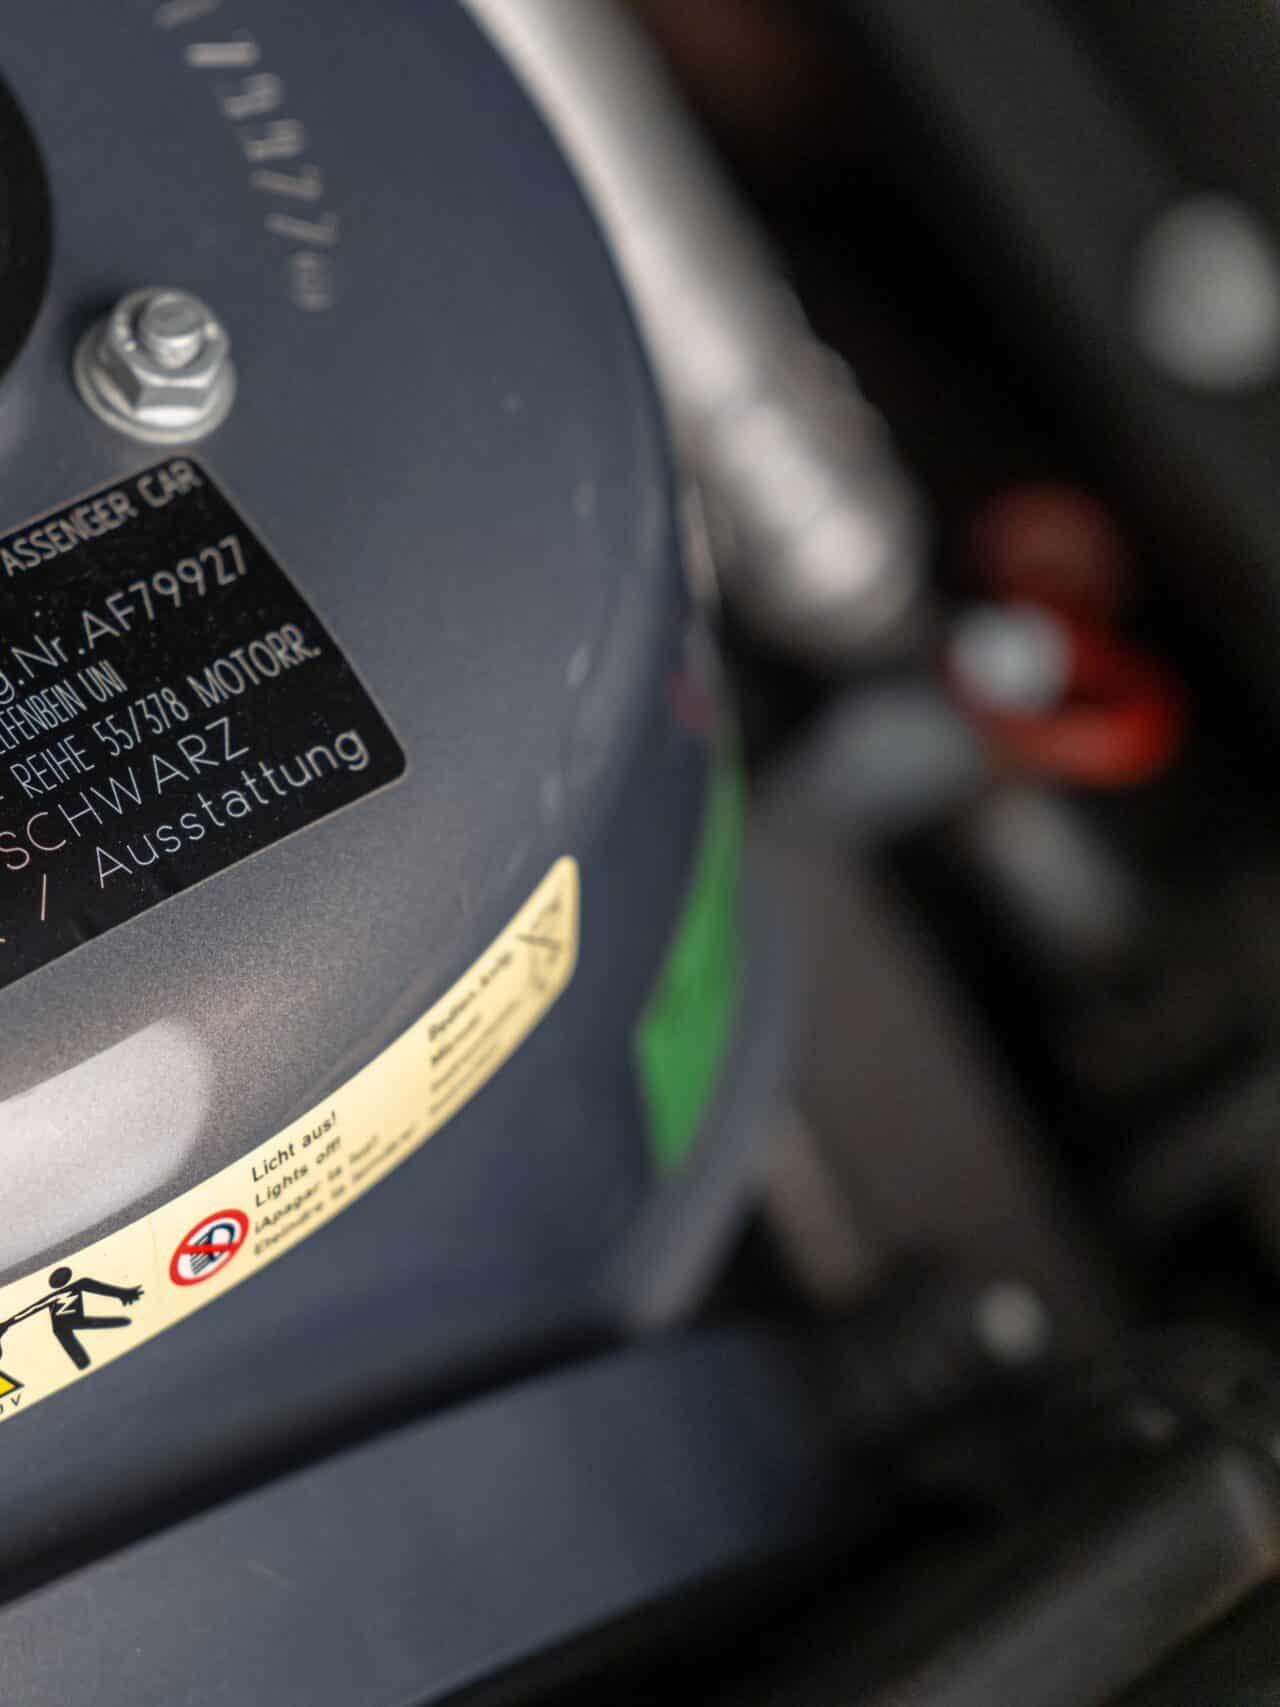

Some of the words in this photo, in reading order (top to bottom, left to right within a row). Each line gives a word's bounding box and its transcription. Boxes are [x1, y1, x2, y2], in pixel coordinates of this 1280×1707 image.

[138, 460, 201, 508] CAR
[76, 660, 128, 703] UNI
[9, 735, 95, 799] REIHE
[92, 687, 189, 757] 55/378
[187, 624, 321, 708] MOTORR.
[95, 729, 370, 888] Ausstattung
[251, 1143, 296, 1183] Licht
[302, 1109, 336, 1148] aus!
[255, 1164, 309, 1207] Lights
[9, 1394, 25, 1407] V
